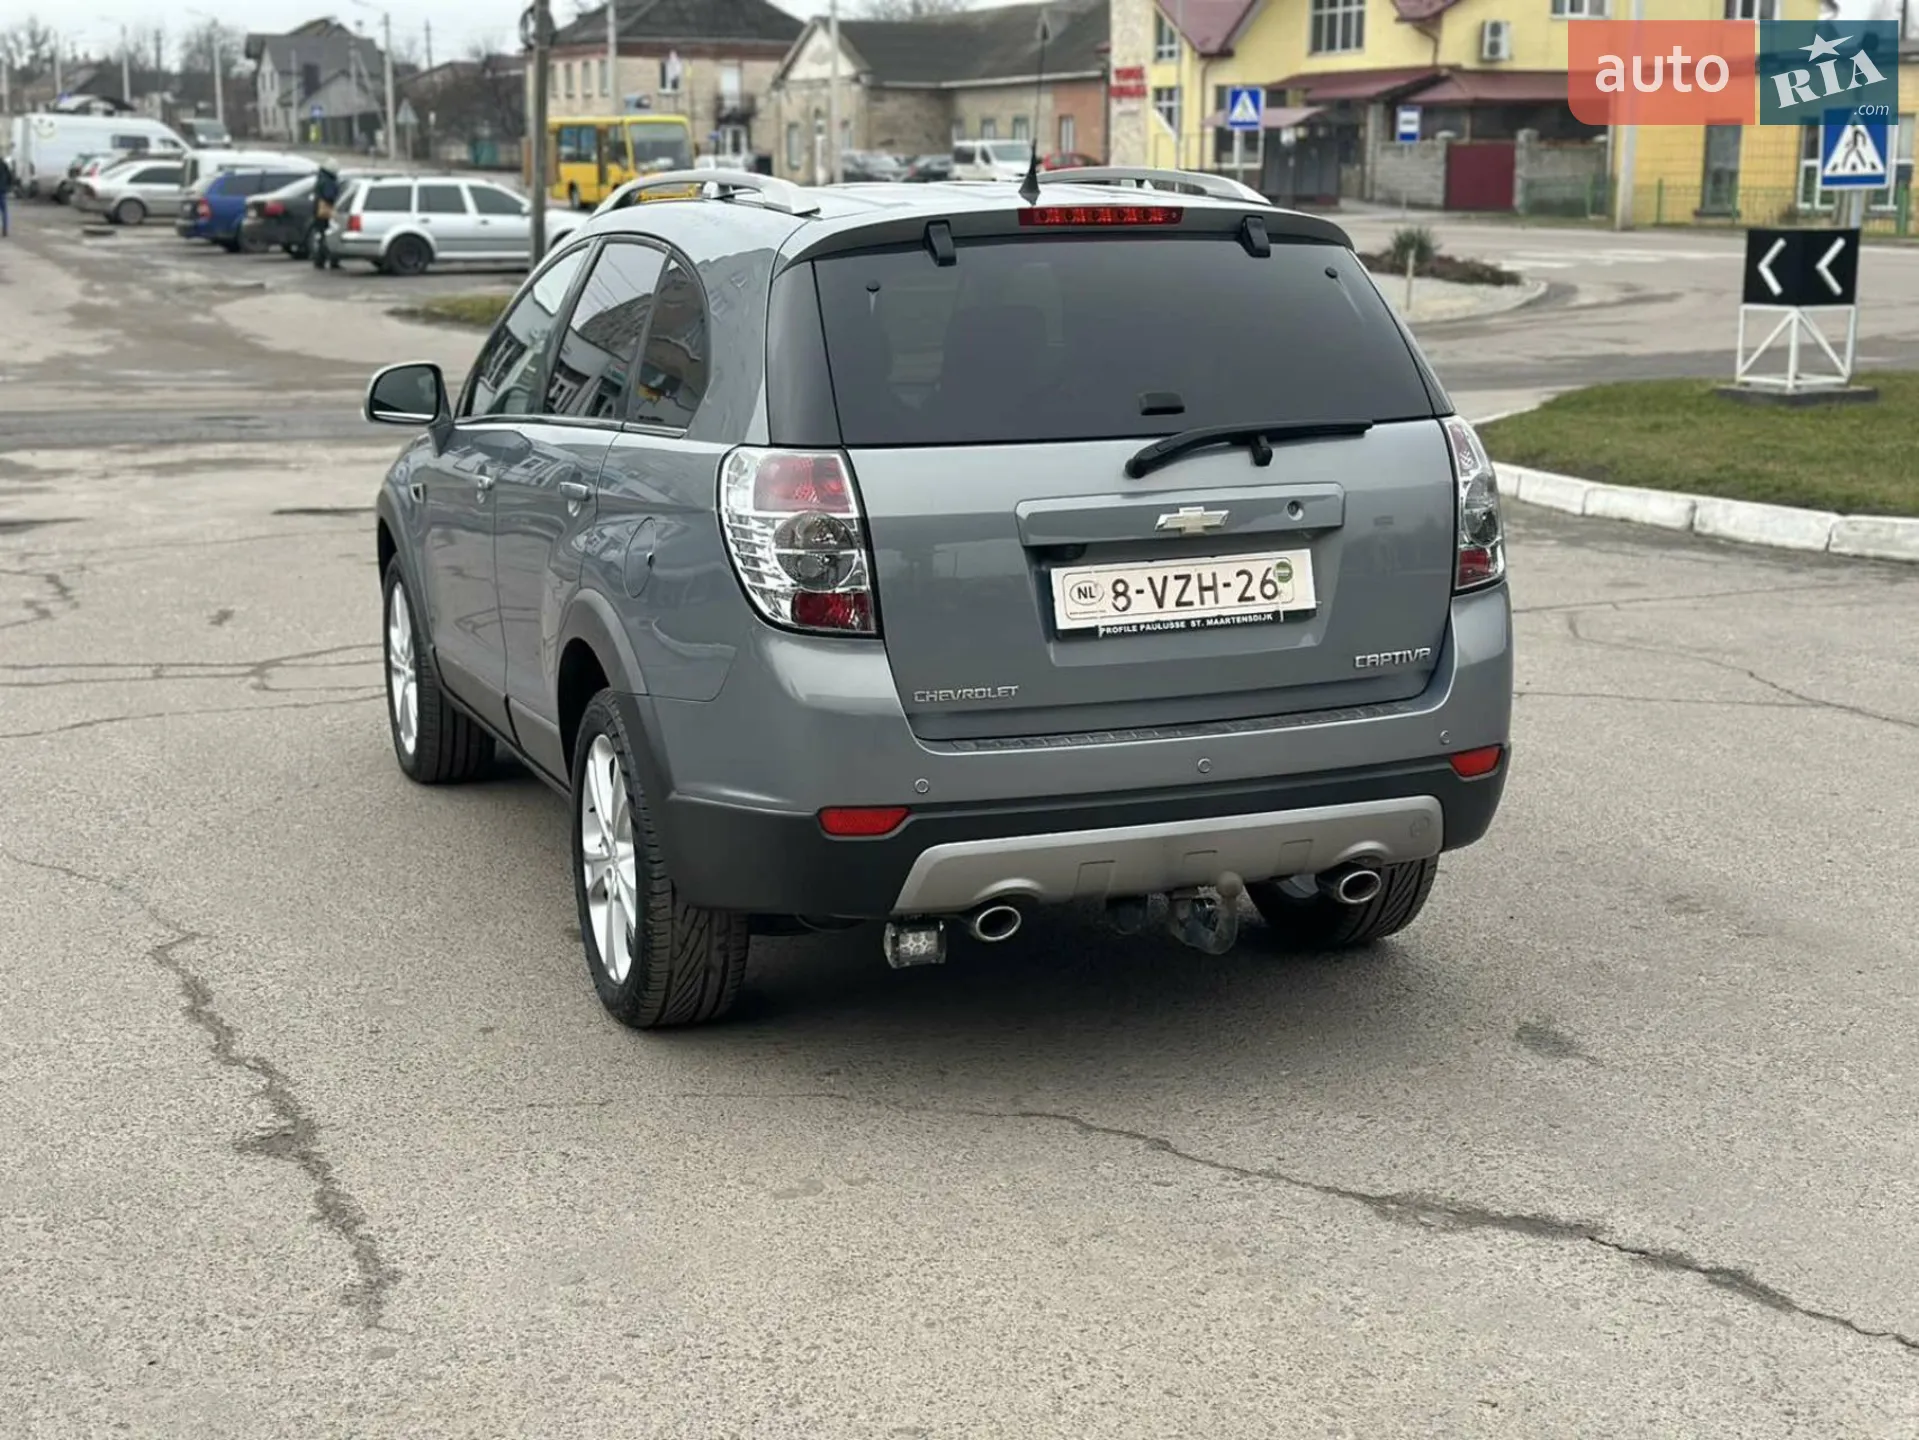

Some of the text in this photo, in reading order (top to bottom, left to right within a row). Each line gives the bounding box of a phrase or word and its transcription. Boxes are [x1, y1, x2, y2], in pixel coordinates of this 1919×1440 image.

[1077, 586, 1096, 600] NL
[1111, 567, 1278, 612] 8-VZH-26
[1100, 626, 1138, 635] PROFILE
[1190, 619, 1206, 628] ST.
[1355, 647, 1431, 668] CAPTIVA
[914, 685, 1020, 702] CHEVROLET
